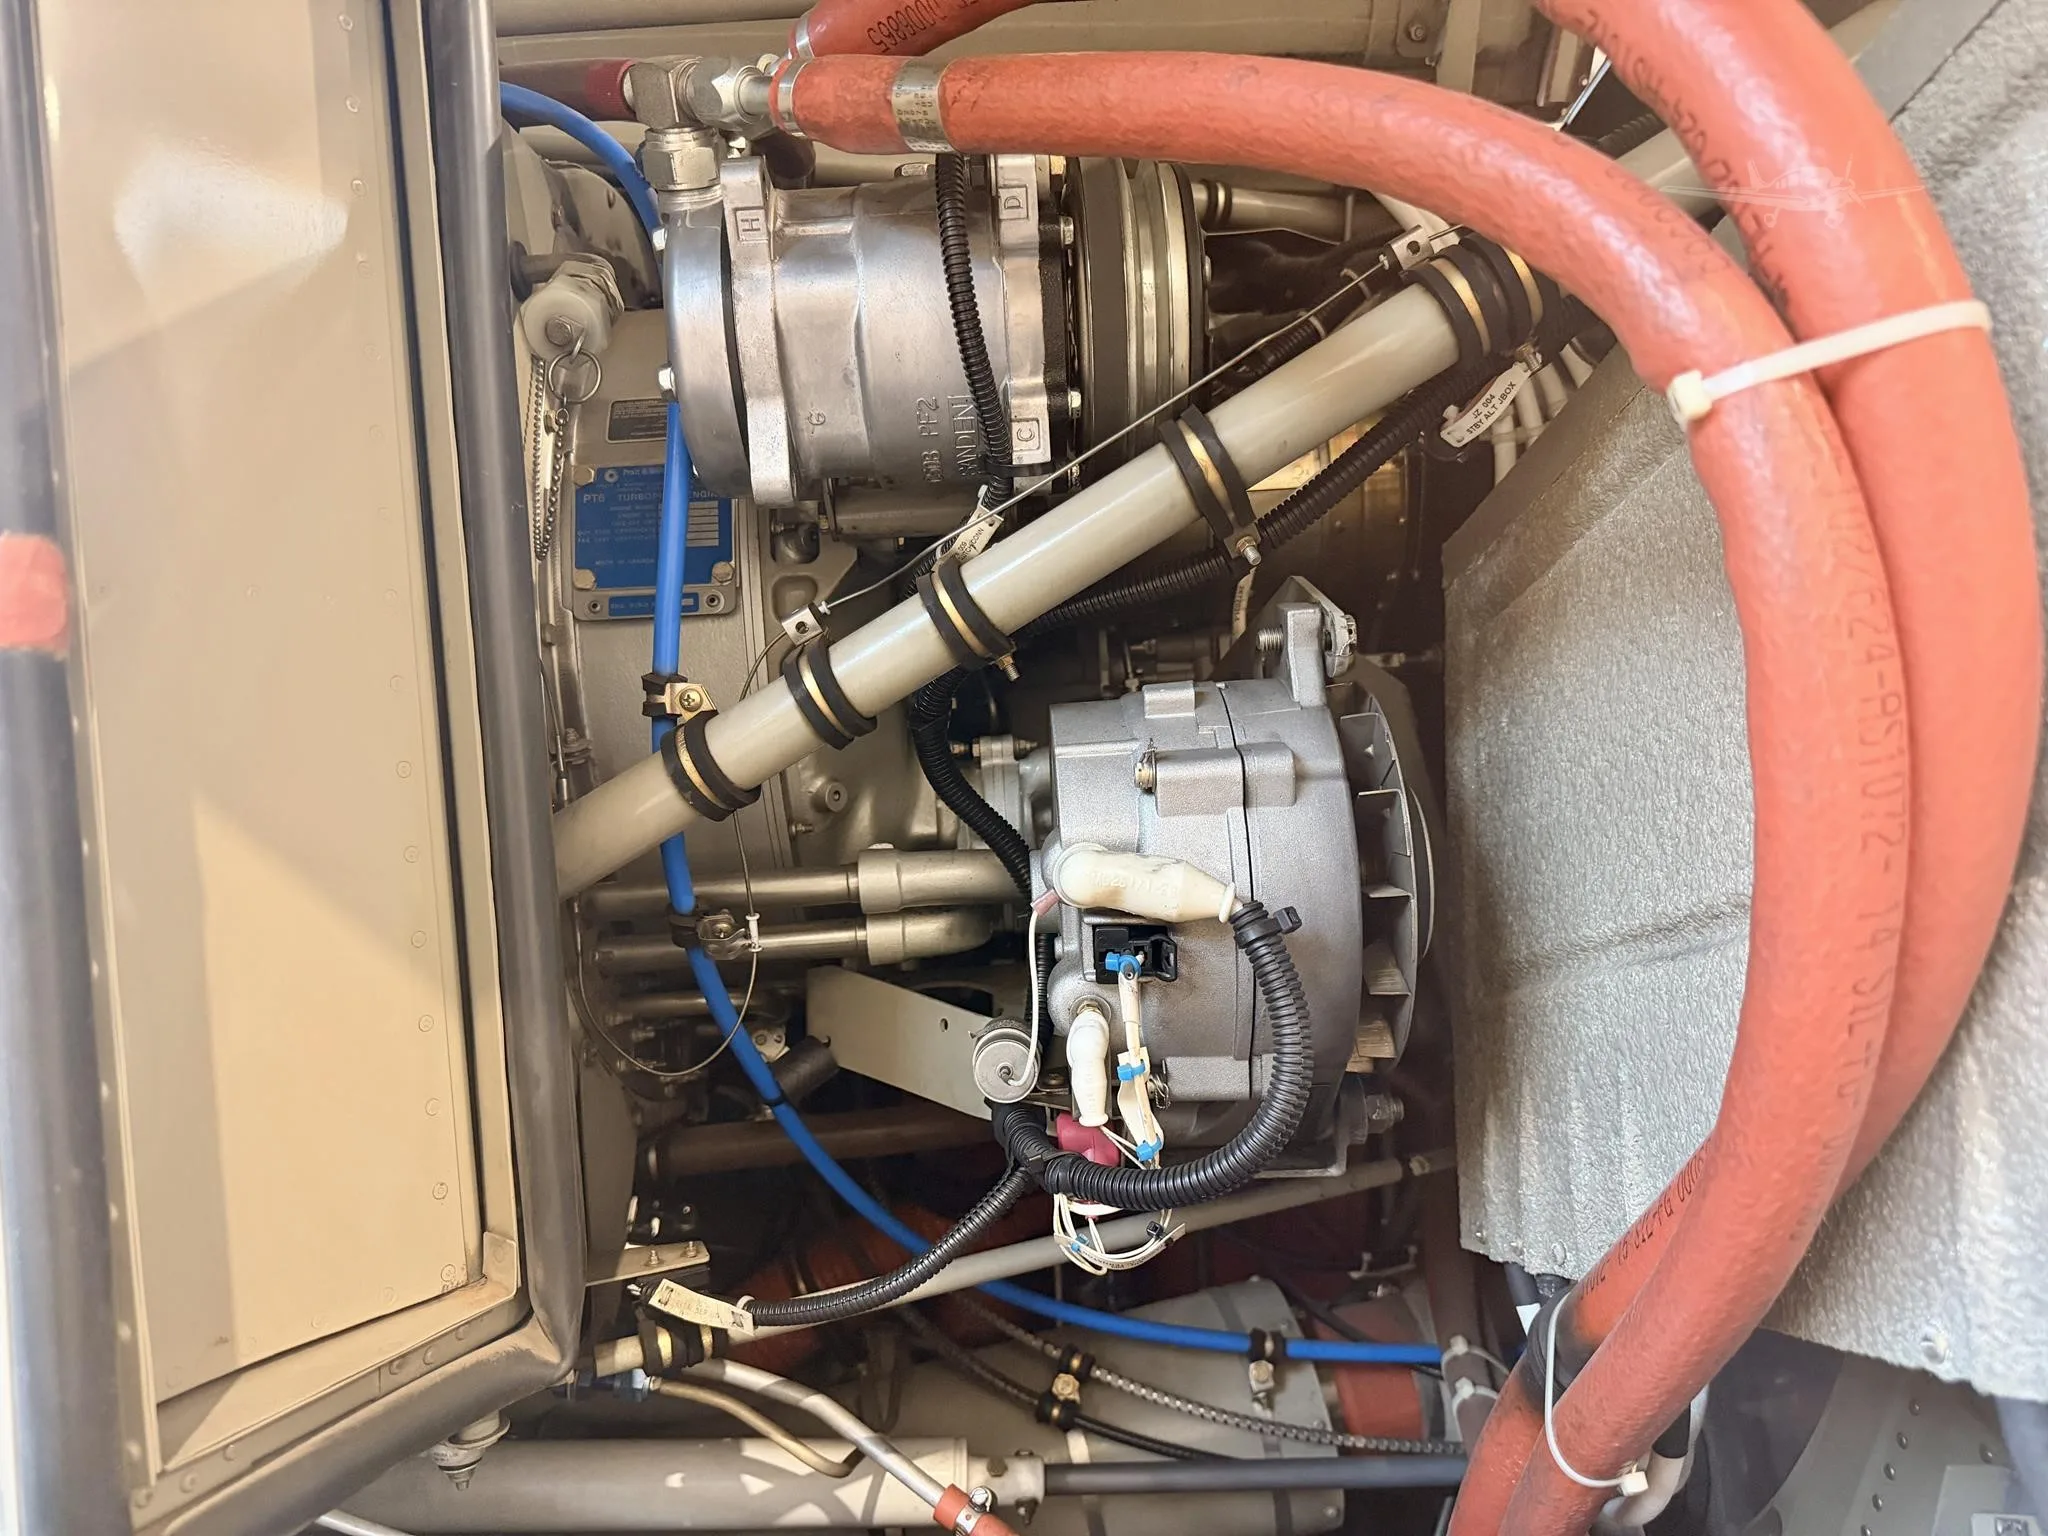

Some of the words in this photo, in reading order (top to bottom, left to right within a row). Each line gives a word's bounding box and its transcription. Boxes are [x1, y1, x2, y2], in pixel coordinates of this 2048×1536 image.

[1003, 196, 1024, 210] D
[740, 217, 761, 233] H
[1466, 418, 1484, 434] STBY
[1483, 404, 1498, 420] ALT
[1499, 381, 1517, 405] JBOX
[1472, 408, 1483, 419] JZ
[1482, 393, 1496, 408] 004
[1016, 427, 1036, 442] C
